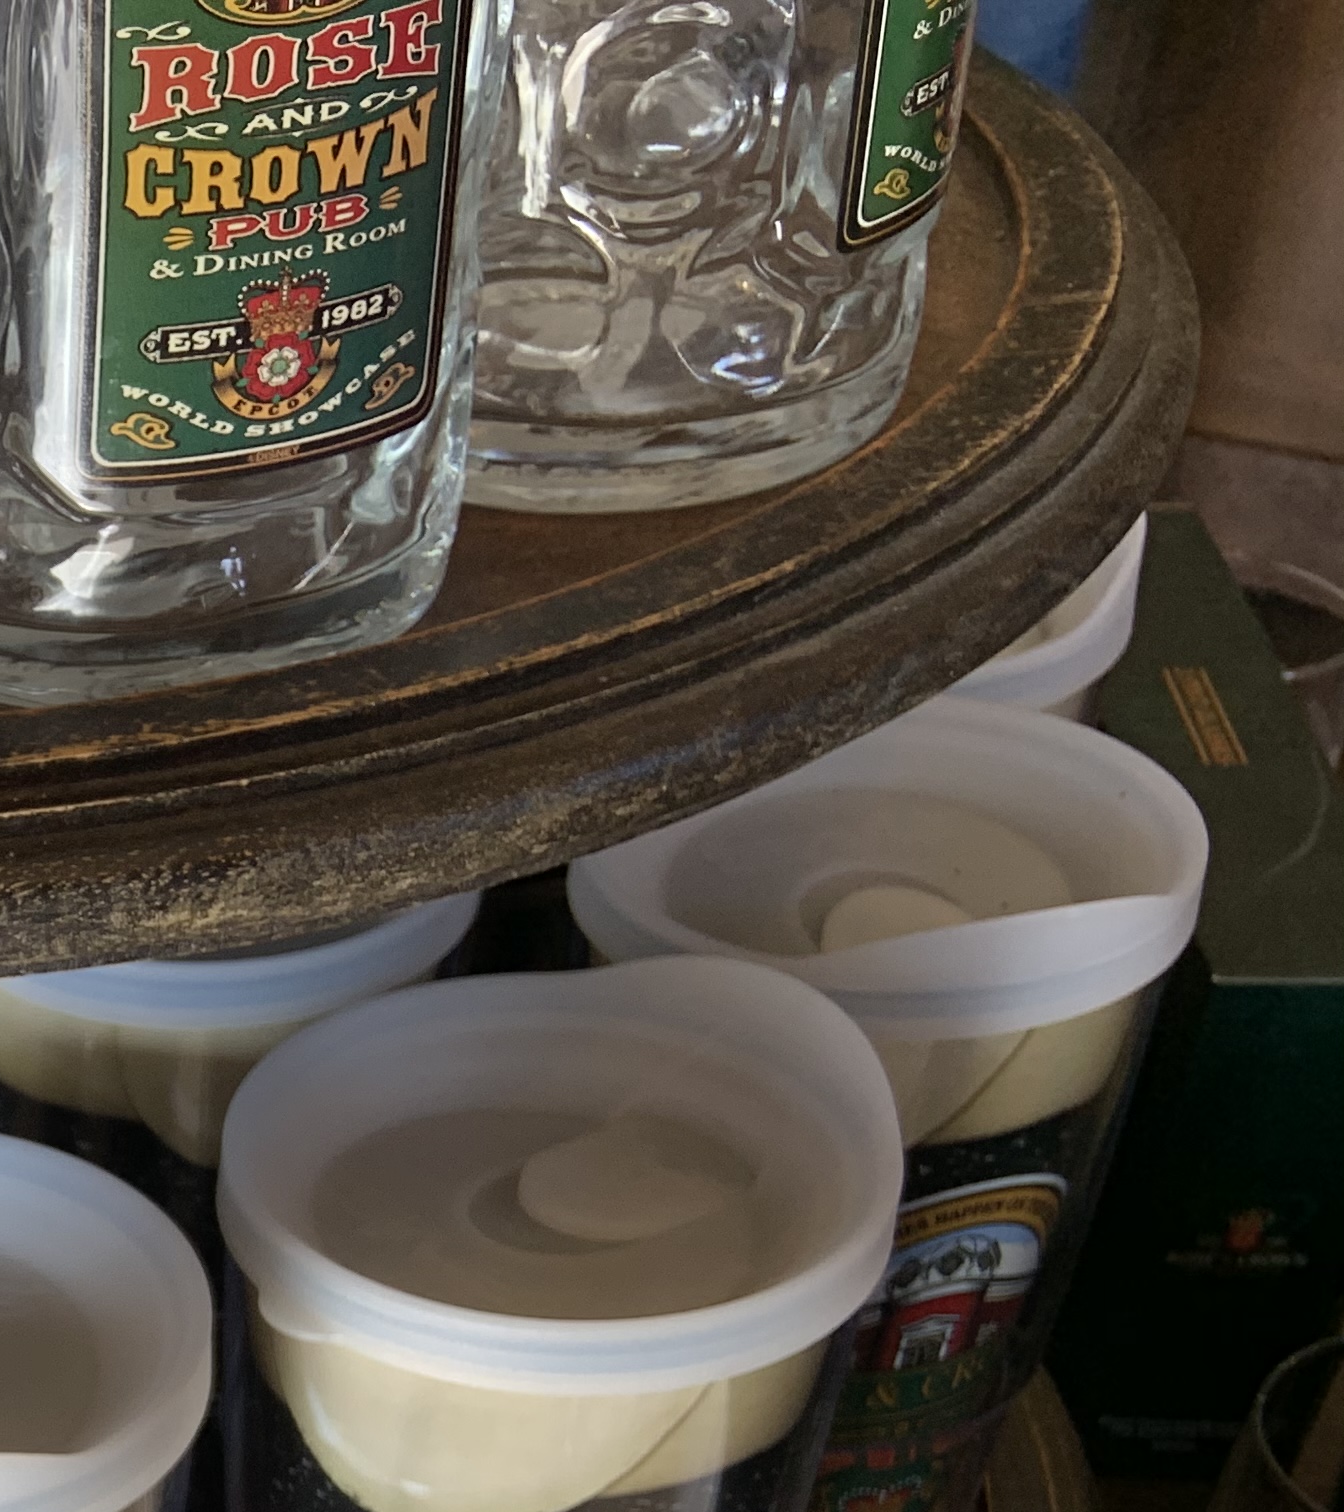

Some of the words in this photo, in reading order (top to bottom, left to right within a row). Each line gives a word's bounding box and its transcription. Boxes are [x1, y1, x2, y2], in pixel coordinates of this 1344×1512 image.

[128, 0, 443, 133] ROSE
[241, 99, 352, 136] AND
[123, 86, 439, 219] CROWN
[884, 144, 938, 173] WORLD
[208, 193, 370, 250] PUB
[149, 258, 185, 280] &
[167, 325, 243, 354] EST.
[321, 293, 385, 330] 1982
[119, 383, 235, 437] WORLD
[243, 329, 417, 438] SHOWCASE
[232, 386, 320, 418] EPCOT
